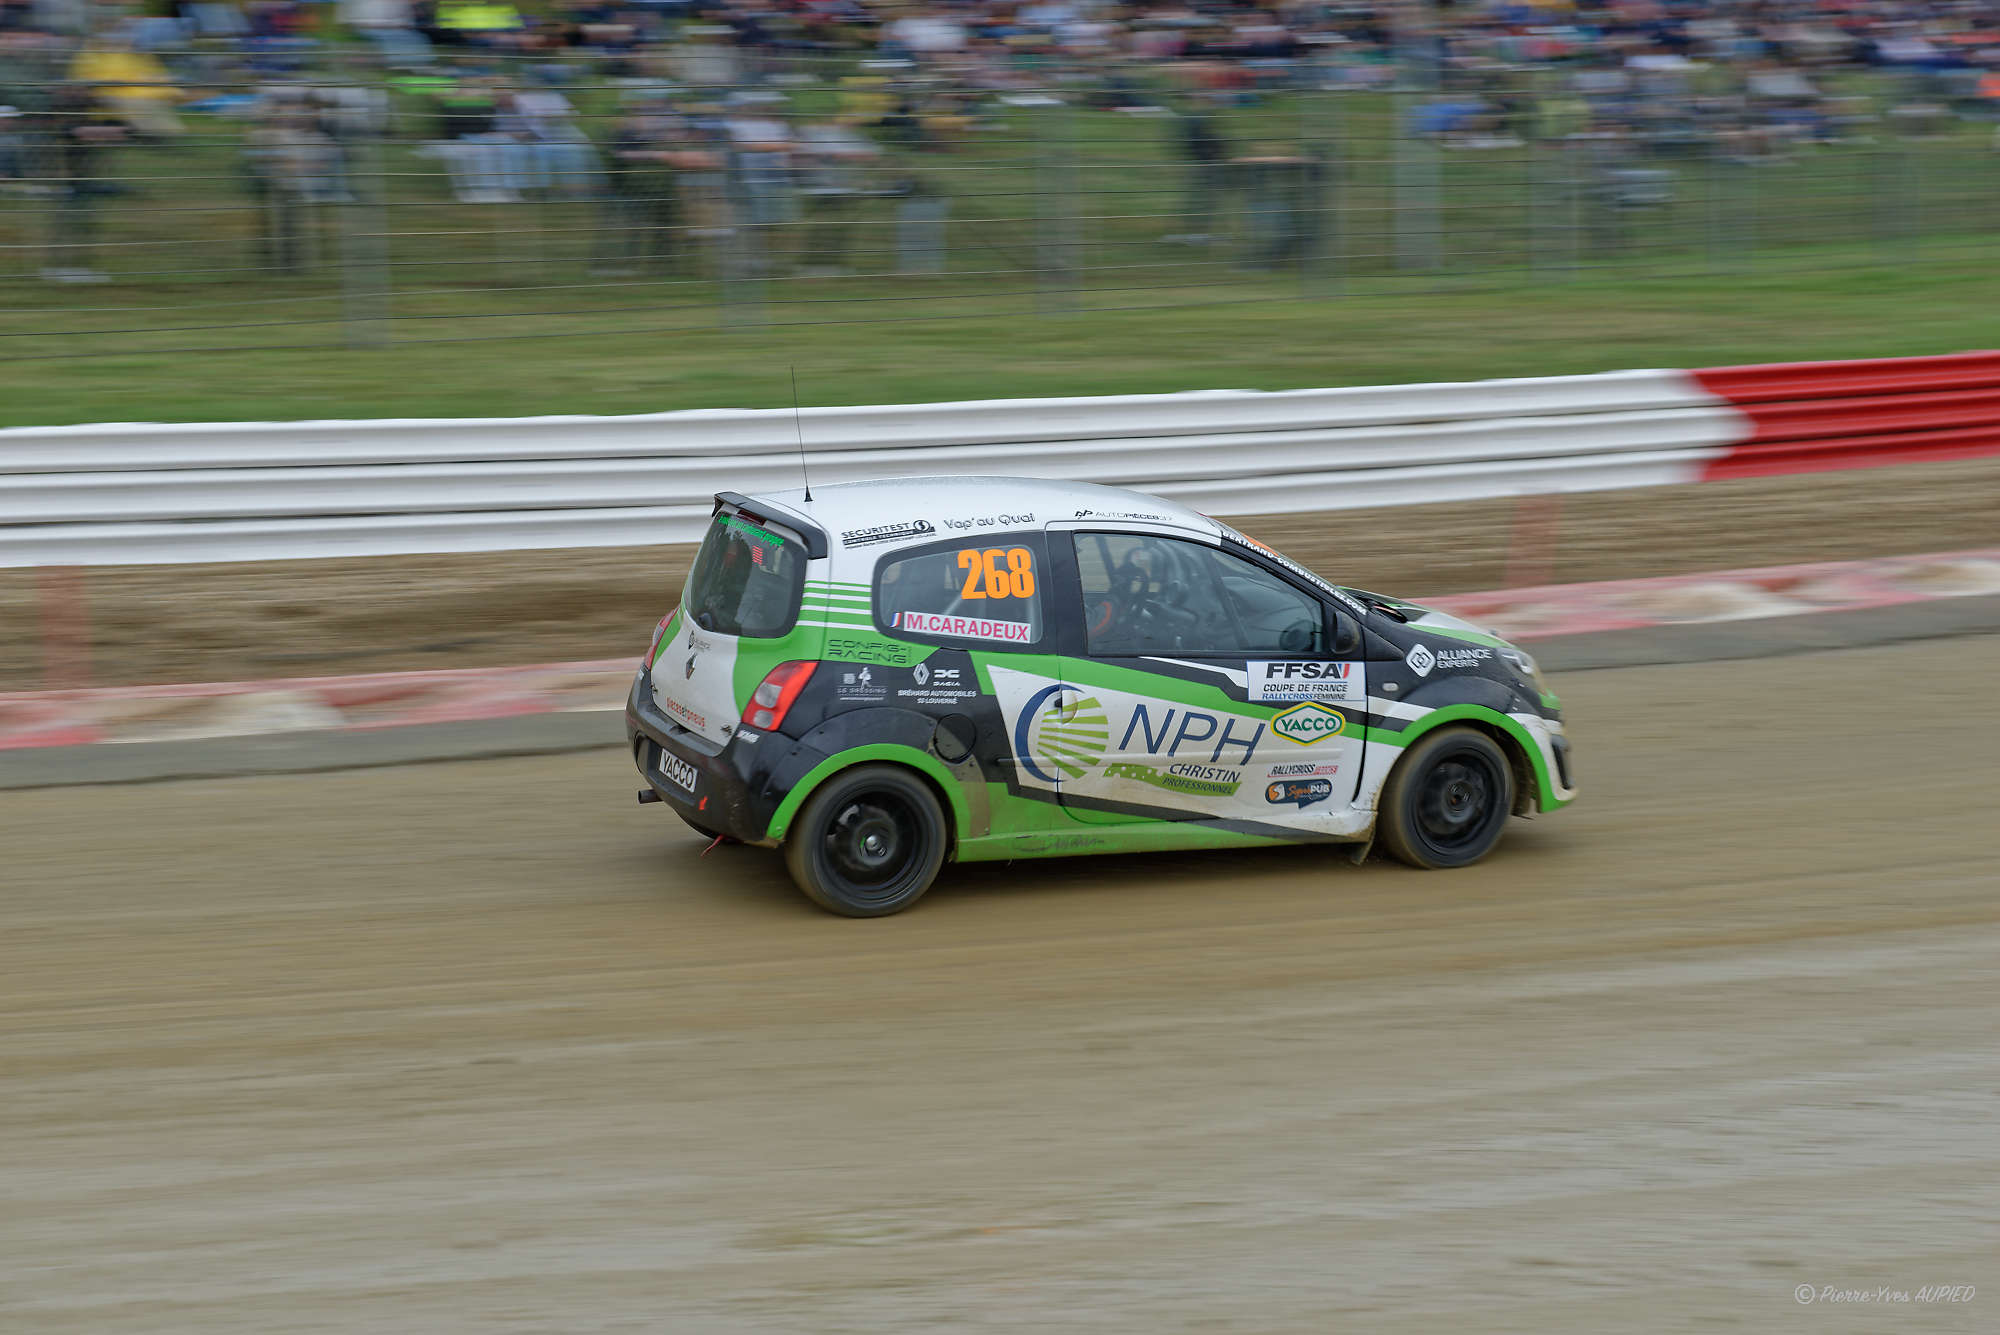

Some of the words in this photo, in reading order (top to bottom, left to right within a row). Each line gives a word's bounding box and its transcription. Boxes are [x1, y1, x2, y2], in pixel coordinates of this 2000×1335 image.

[999, 513, 1035, 525] Quai
[841, 523, 910, 538] SECURITEST
[957, 548, 1035, 599] 268
[906, 614, 1028, 641] M.CARADEUX
[828, 649, 906, 663] RACING
[1437, 649, 1493, 660] ALLIANCE
[1266, 663, 1341, 679] FFSA
[1437, 660, 1479, 669] EXPERTS
[930, 690, 977, 698] AUTOMOBILES
[1263, 684, 1295, 692] COUPE
[1297, 684, 1310, 692] DE
[1311, 684, 1348, 692] FRANCE
[1280, 718, 1336, 731] YACCO
[1118, 703, 1266, 766] NPH
[663, 752, 695, 788] YACCO
[1169, 763, 1241, 783] CHRISTIN
[1271, 764, 1316, 775] RALLYCROSS
[1162, 777, 1234, 794] PROFESSIONNEL
